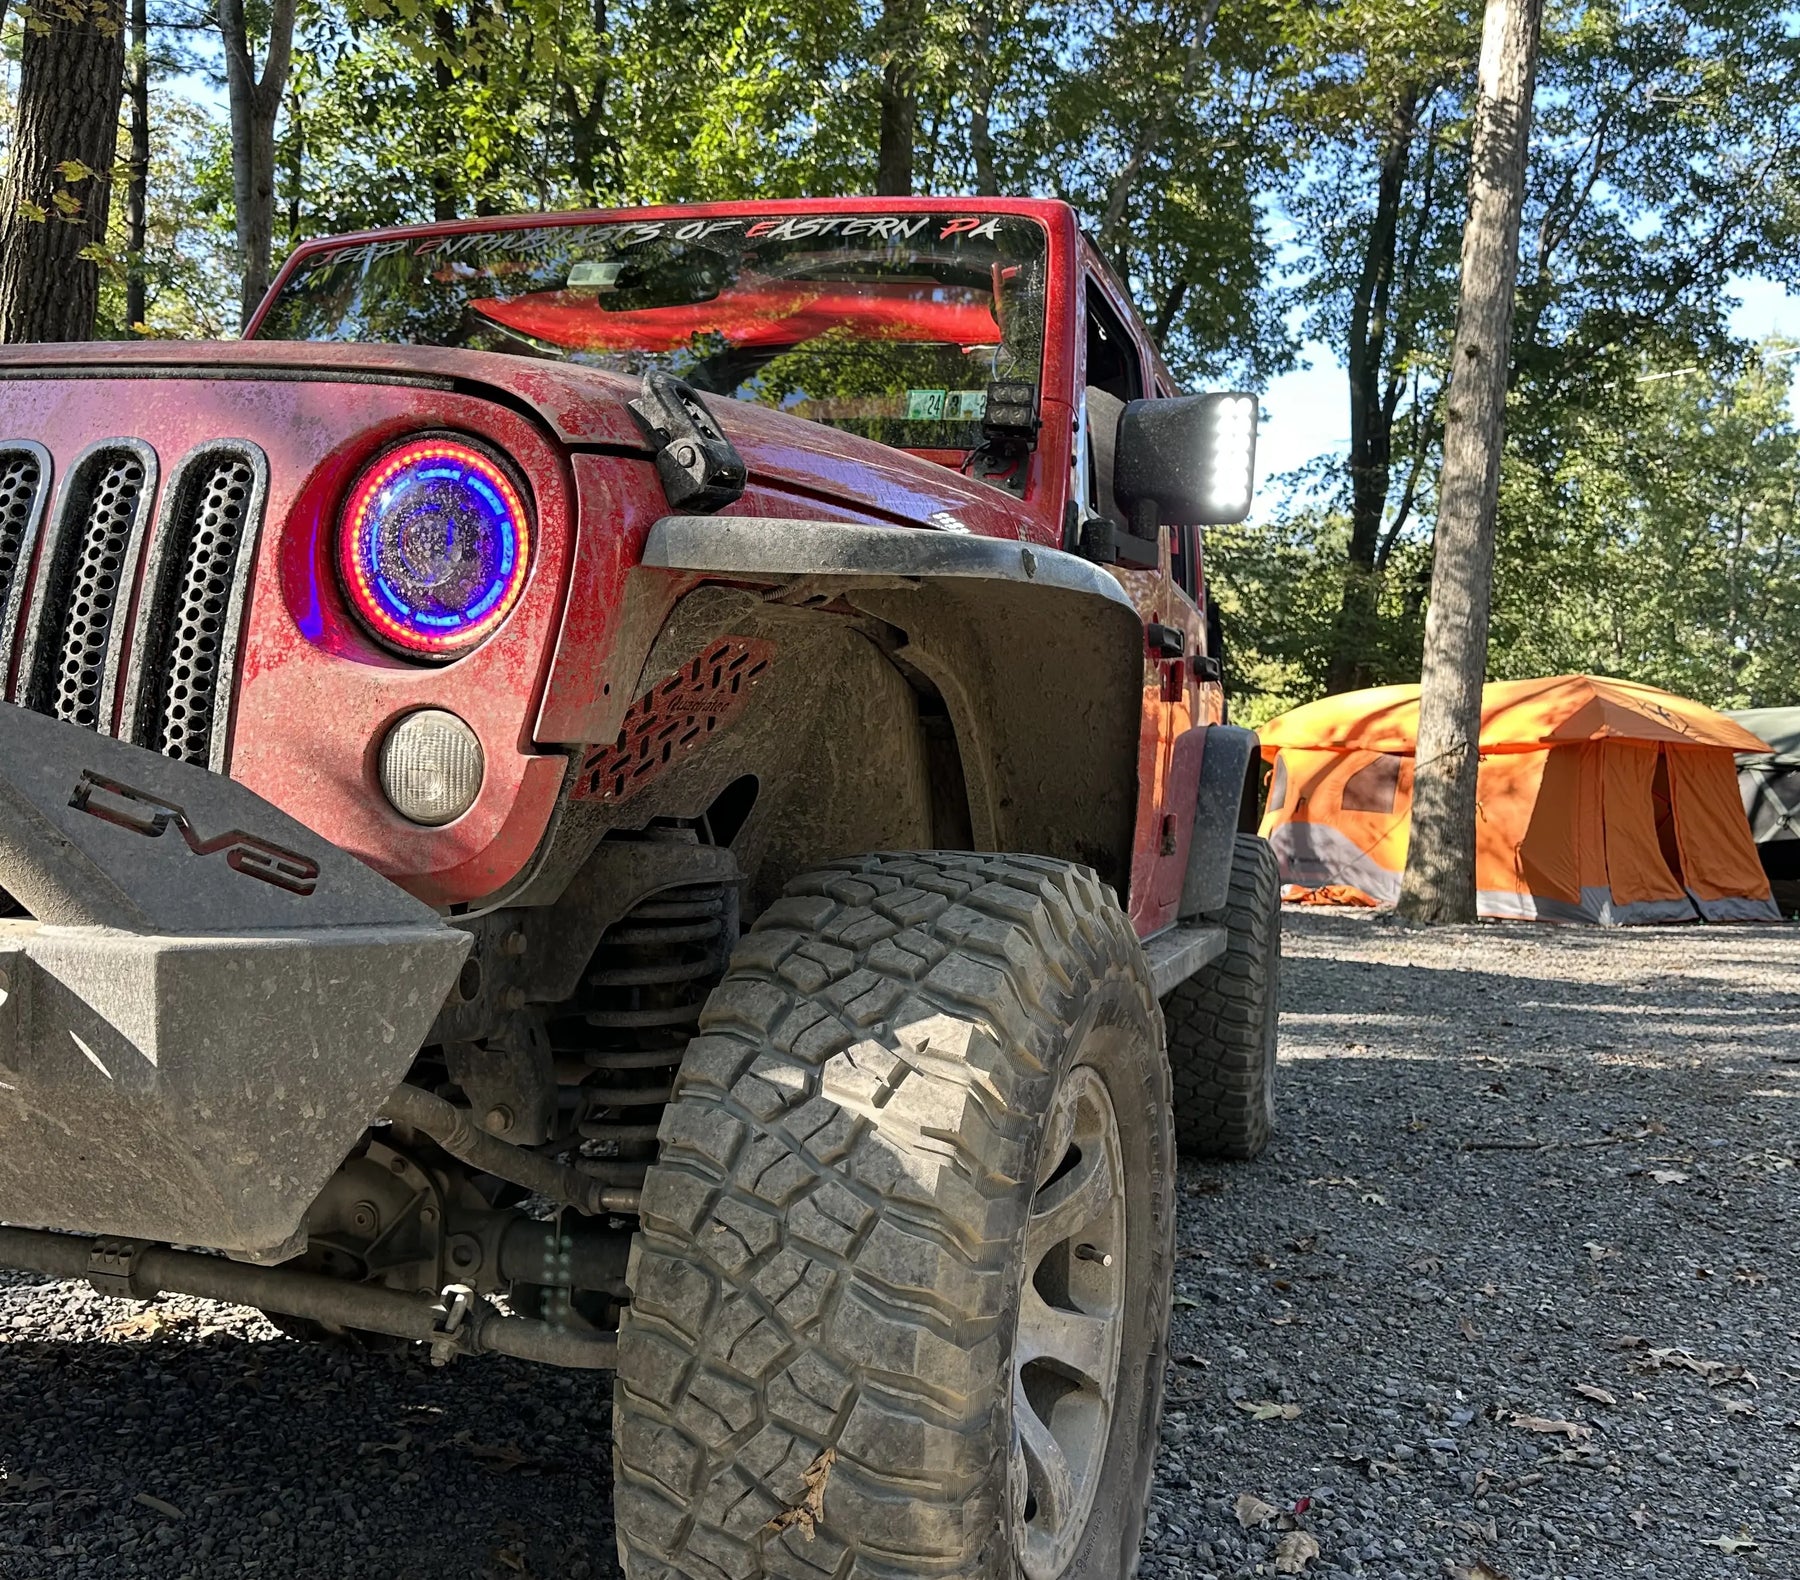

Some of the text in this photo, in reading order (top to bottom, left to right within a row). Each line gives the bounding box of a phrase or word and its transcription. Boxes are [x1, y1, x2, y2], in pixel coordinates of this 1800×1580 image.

[310, 217, 1003, 267] JEEP ENTHUSIASTS OF EASTERN PA
[927, 394, 941, 415] 24
